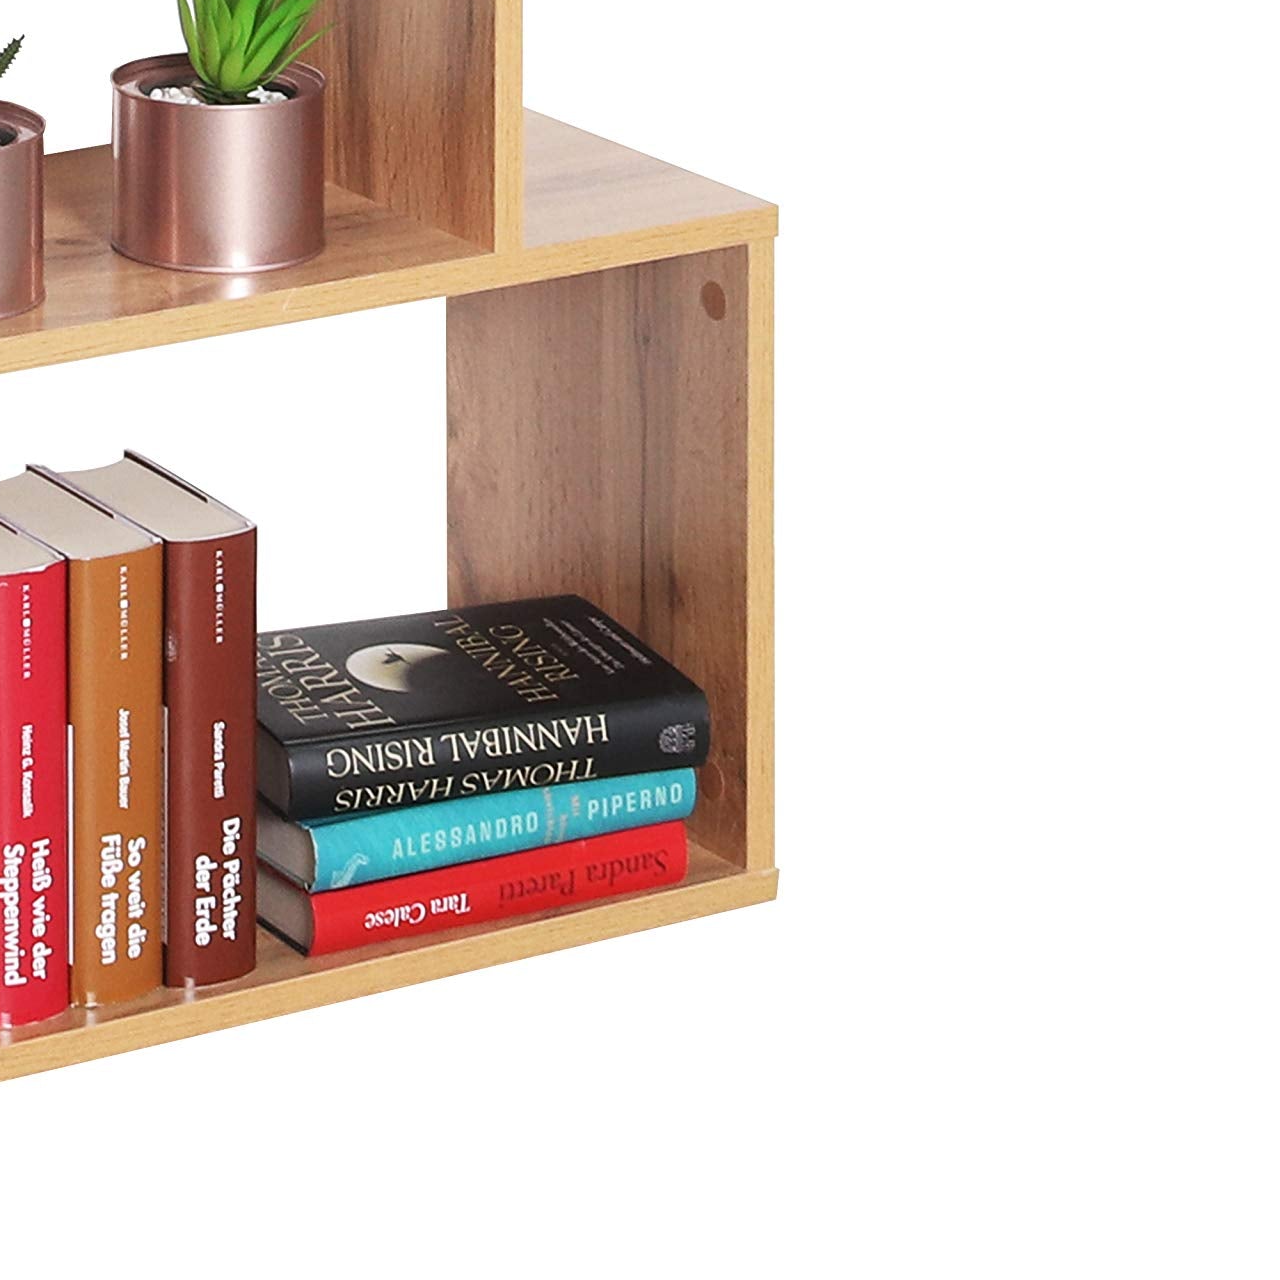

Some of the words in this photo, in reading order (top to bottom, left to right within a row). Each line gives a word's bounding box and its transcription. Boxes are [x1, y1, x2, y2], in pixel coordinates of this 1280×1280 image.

[433, 615, 560, 703] HANNIBAL
[488, 625, 580, 683] RISING
[269, 633, 397, 730] HARRIS
[21, 724, 33, 757] Heinz
[118, 708, 131, 739] Josef
[213, 721, 226, 762] Sandra
[439, 713, 610, 763] HANNIBAL
[21, 757, 34, 770] G.
[119, 739, 130, 776] Martin
[325, 736, 436, 779] RISING
[460, 757, 598, 795] THOMAS
[21, 770, 34, 819] Konsalik
[118, 775, 131, 809] Bauer
[213, 759, 225, 799] Paretti
[333, 776, 455, 813] HARRIS
[222, 817, 241, 856] Die
[391, 811, 539, 860] ALESSANDRO
[587, 782, 684, 821] PIPERNO
[31, 838, 52, 892] Heiß
[101, 834, 124, 888] Füße
[127, 836, 146, 867] So
[586, 848, 669, 887] Sandra
[195, 855, 218, 893] der
[498, 868, 576, 908] Paretti
[127, 870, 146, 919] weit
[222, 858, 242, 941] Pächter
[430, 891, 472, 915] Tara
[31, 895, 51, 938] wie
[95, 892, 120, 965] tragen
[195, 896, 218, 946] Erde
[364, 901, 426, 929] Calese
[32, 941, 53, 980] der
[127, 923, 147, 959] die
